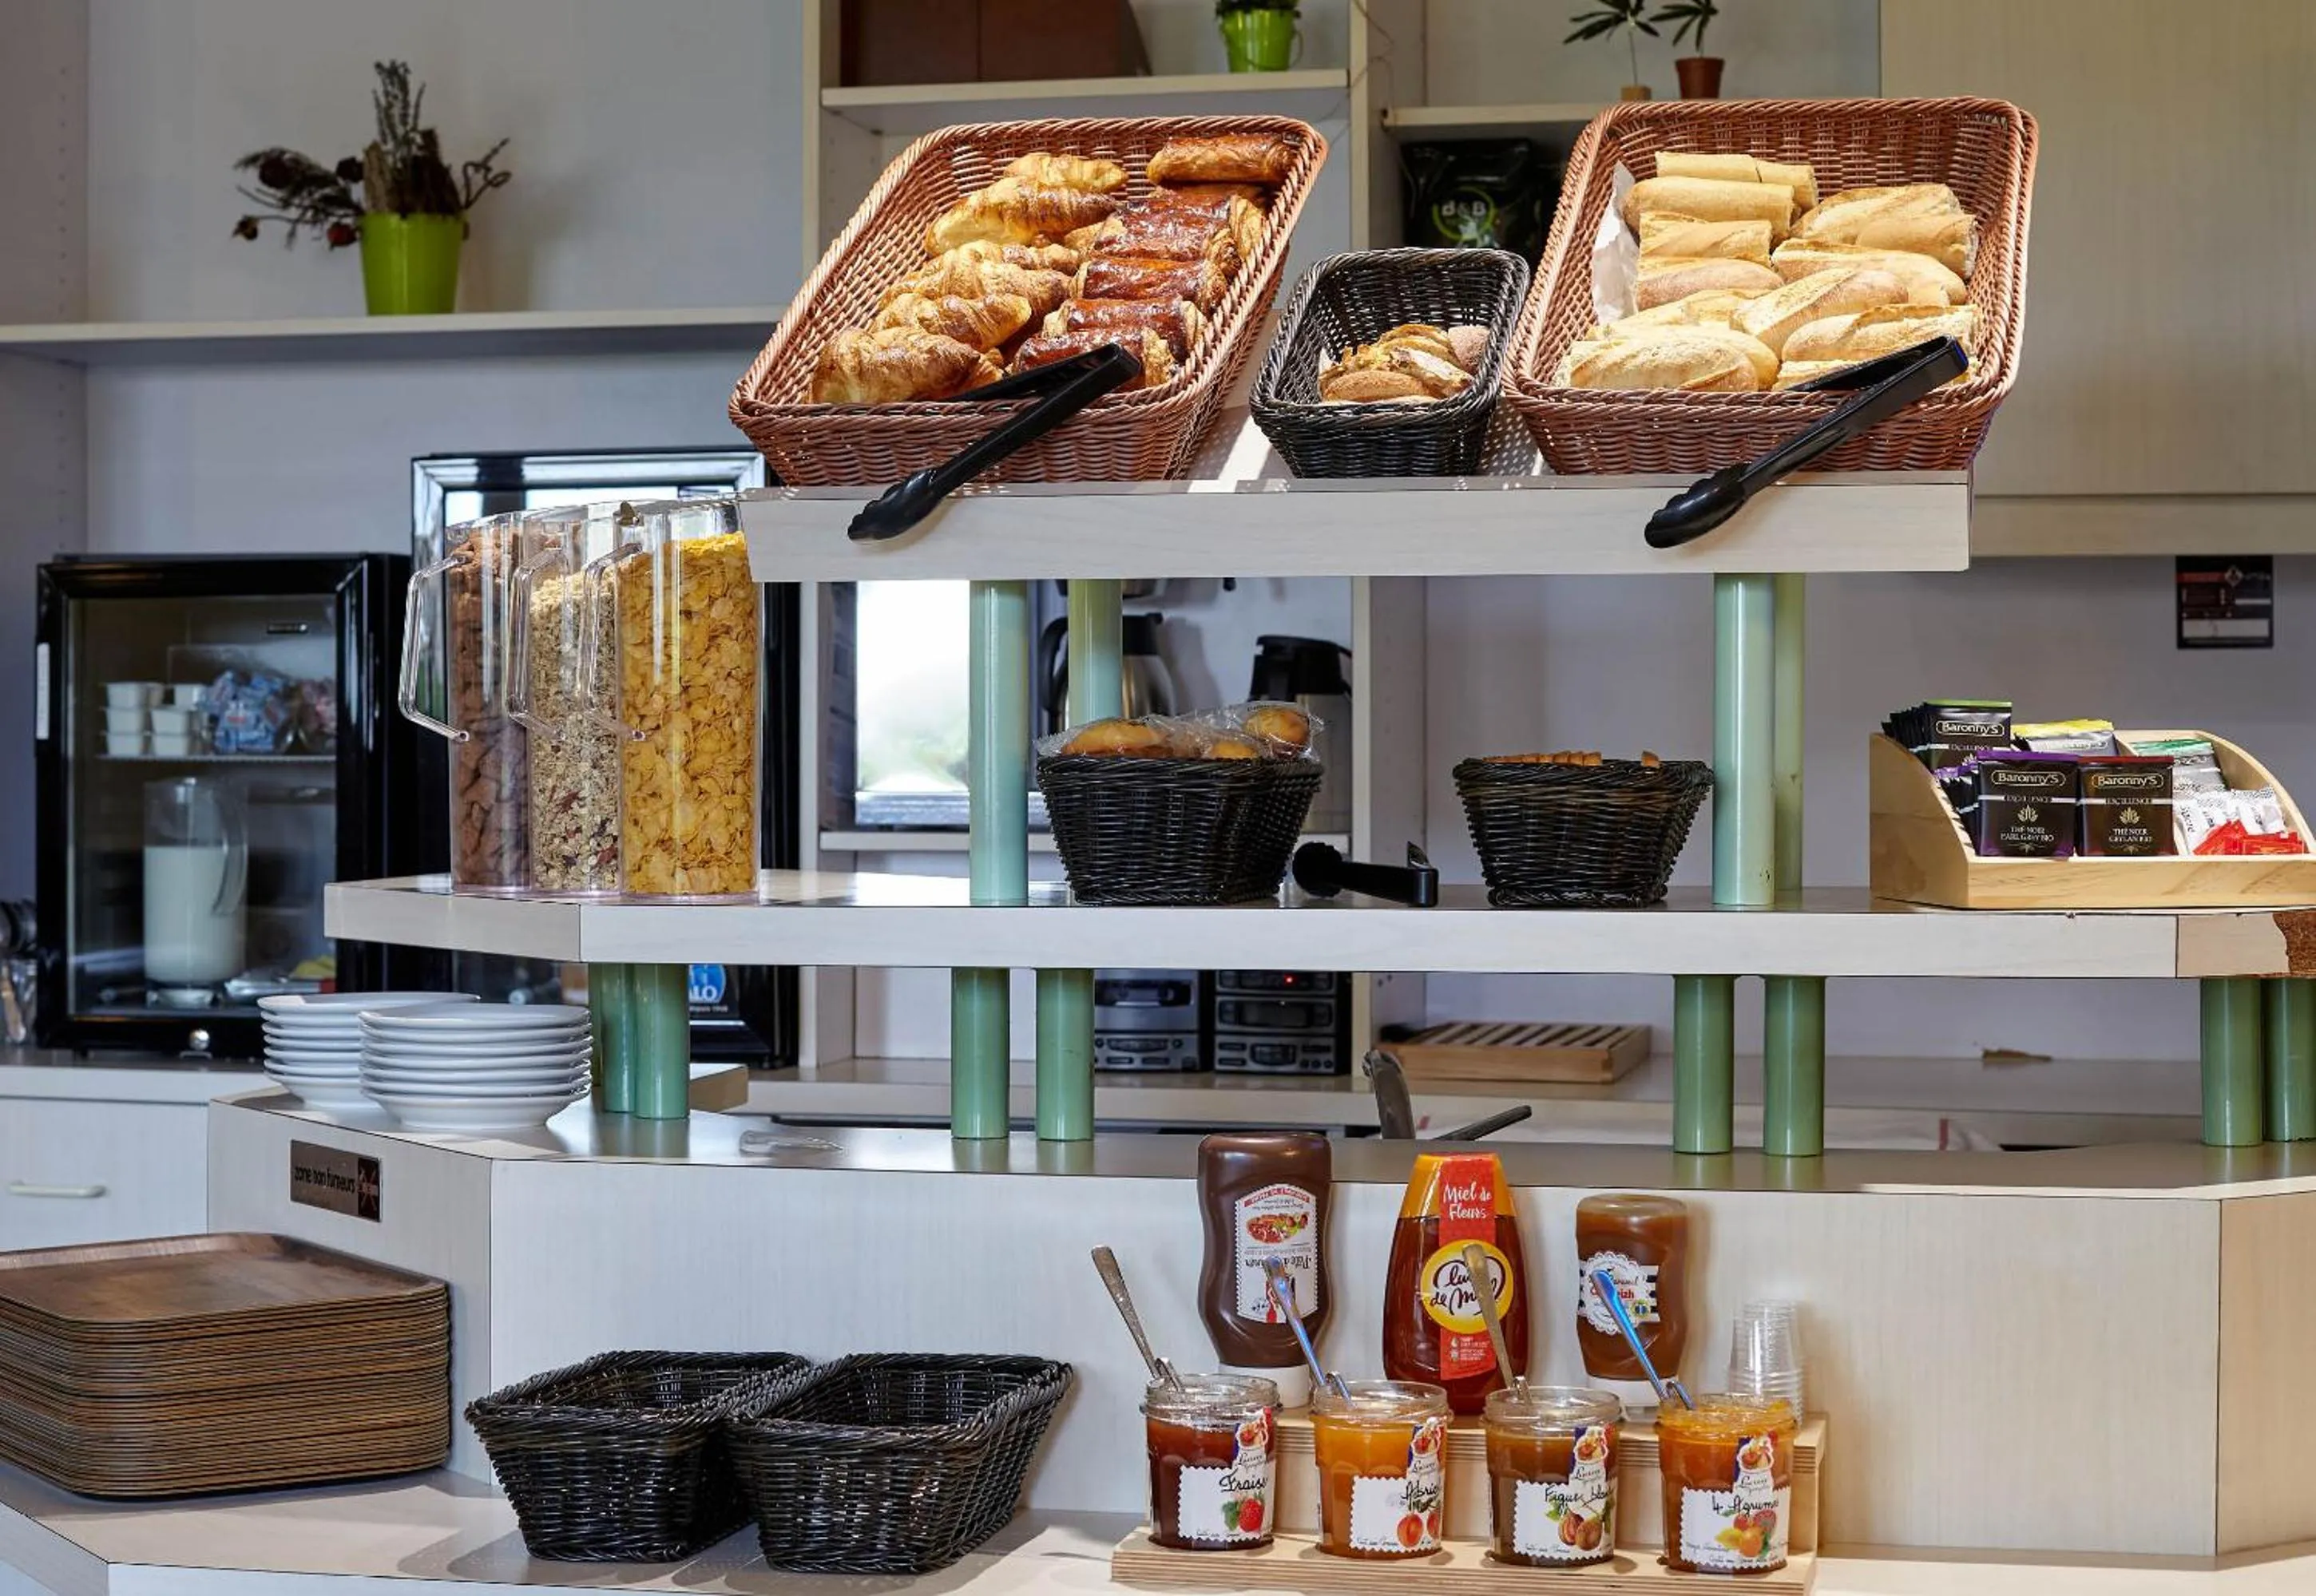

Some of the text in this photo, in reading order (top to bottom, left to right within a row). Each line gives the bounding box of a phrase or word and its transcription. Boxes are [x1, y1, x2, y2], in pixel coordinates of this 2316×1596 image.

[1443, 1182, 1491, 1204] Miel de
[1449, 1202, 1487, 1221] Fleurs
